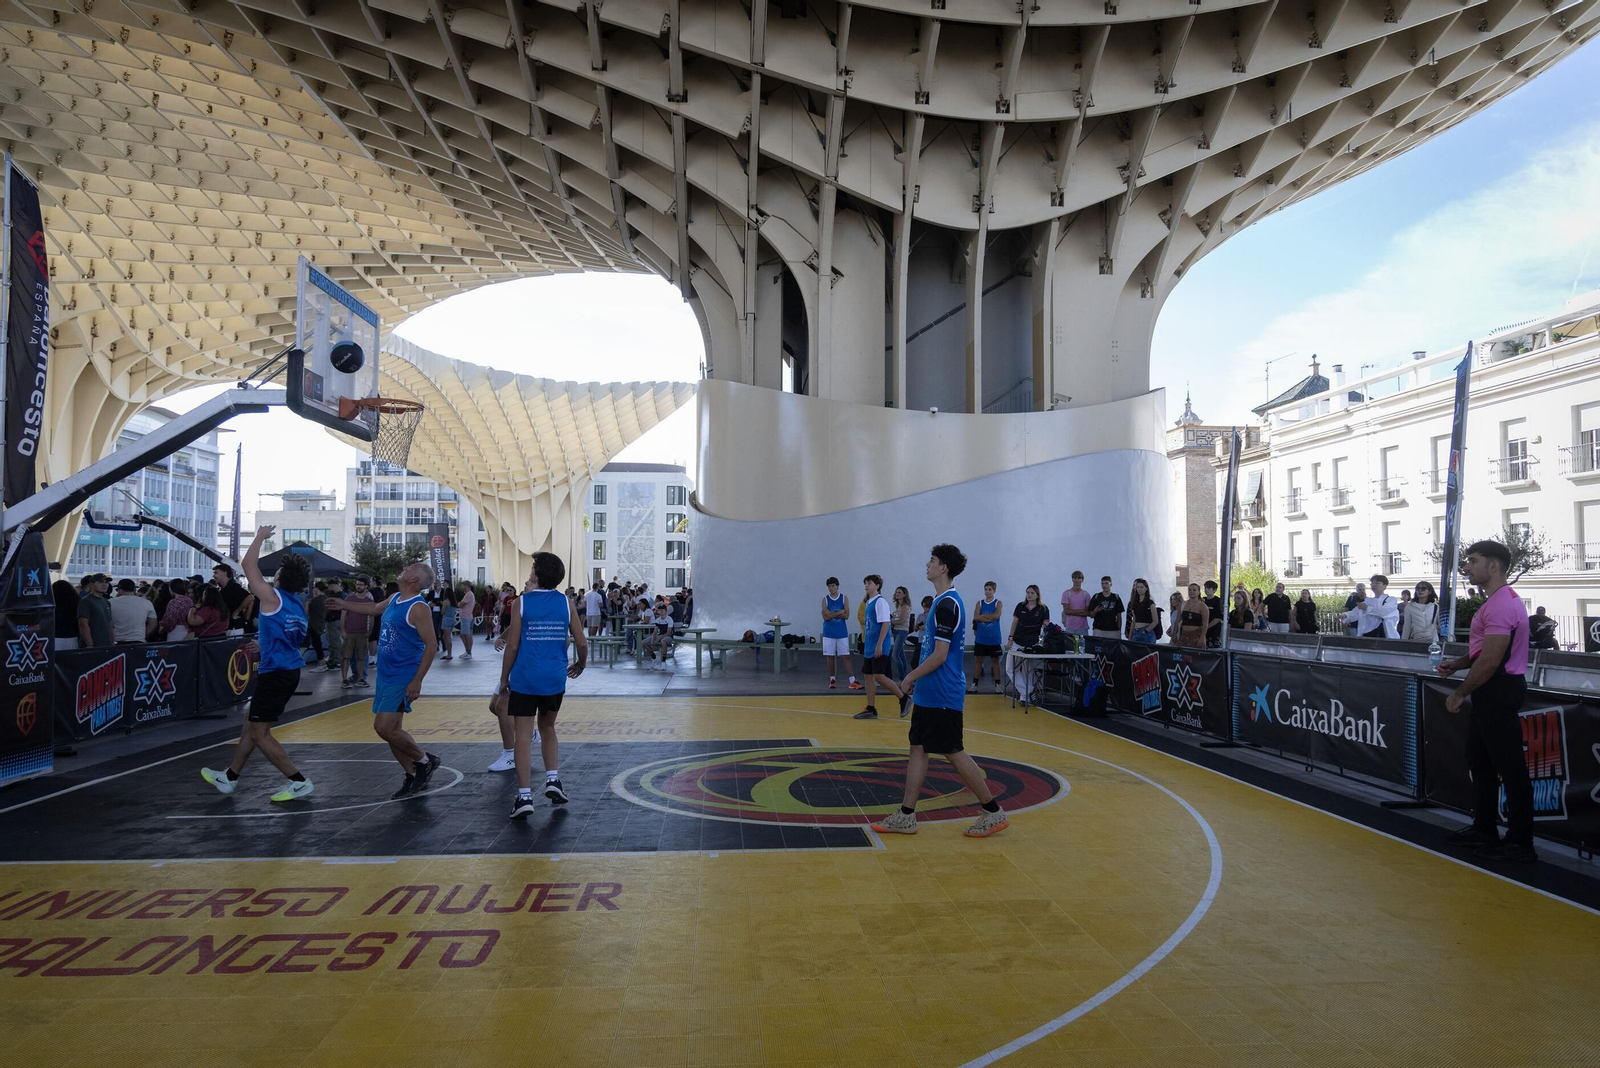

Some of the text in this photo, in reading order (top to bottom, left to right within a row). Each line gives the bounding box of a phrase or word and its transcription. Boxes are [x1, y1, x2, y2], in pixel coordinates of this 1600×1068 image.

[29, 282, 43, 345] ESPAÑA
[9, 671, 46, 686] CaixaBank
[77, 656, 123, 721] CANCHA
[136, 704, 172, 722] CaixaBank
[1171, 708, 1202, 728] CaixaBank
[1274, 688, 1388, 749] CaixaBank
[361, 882, 623, 916] MUJER
